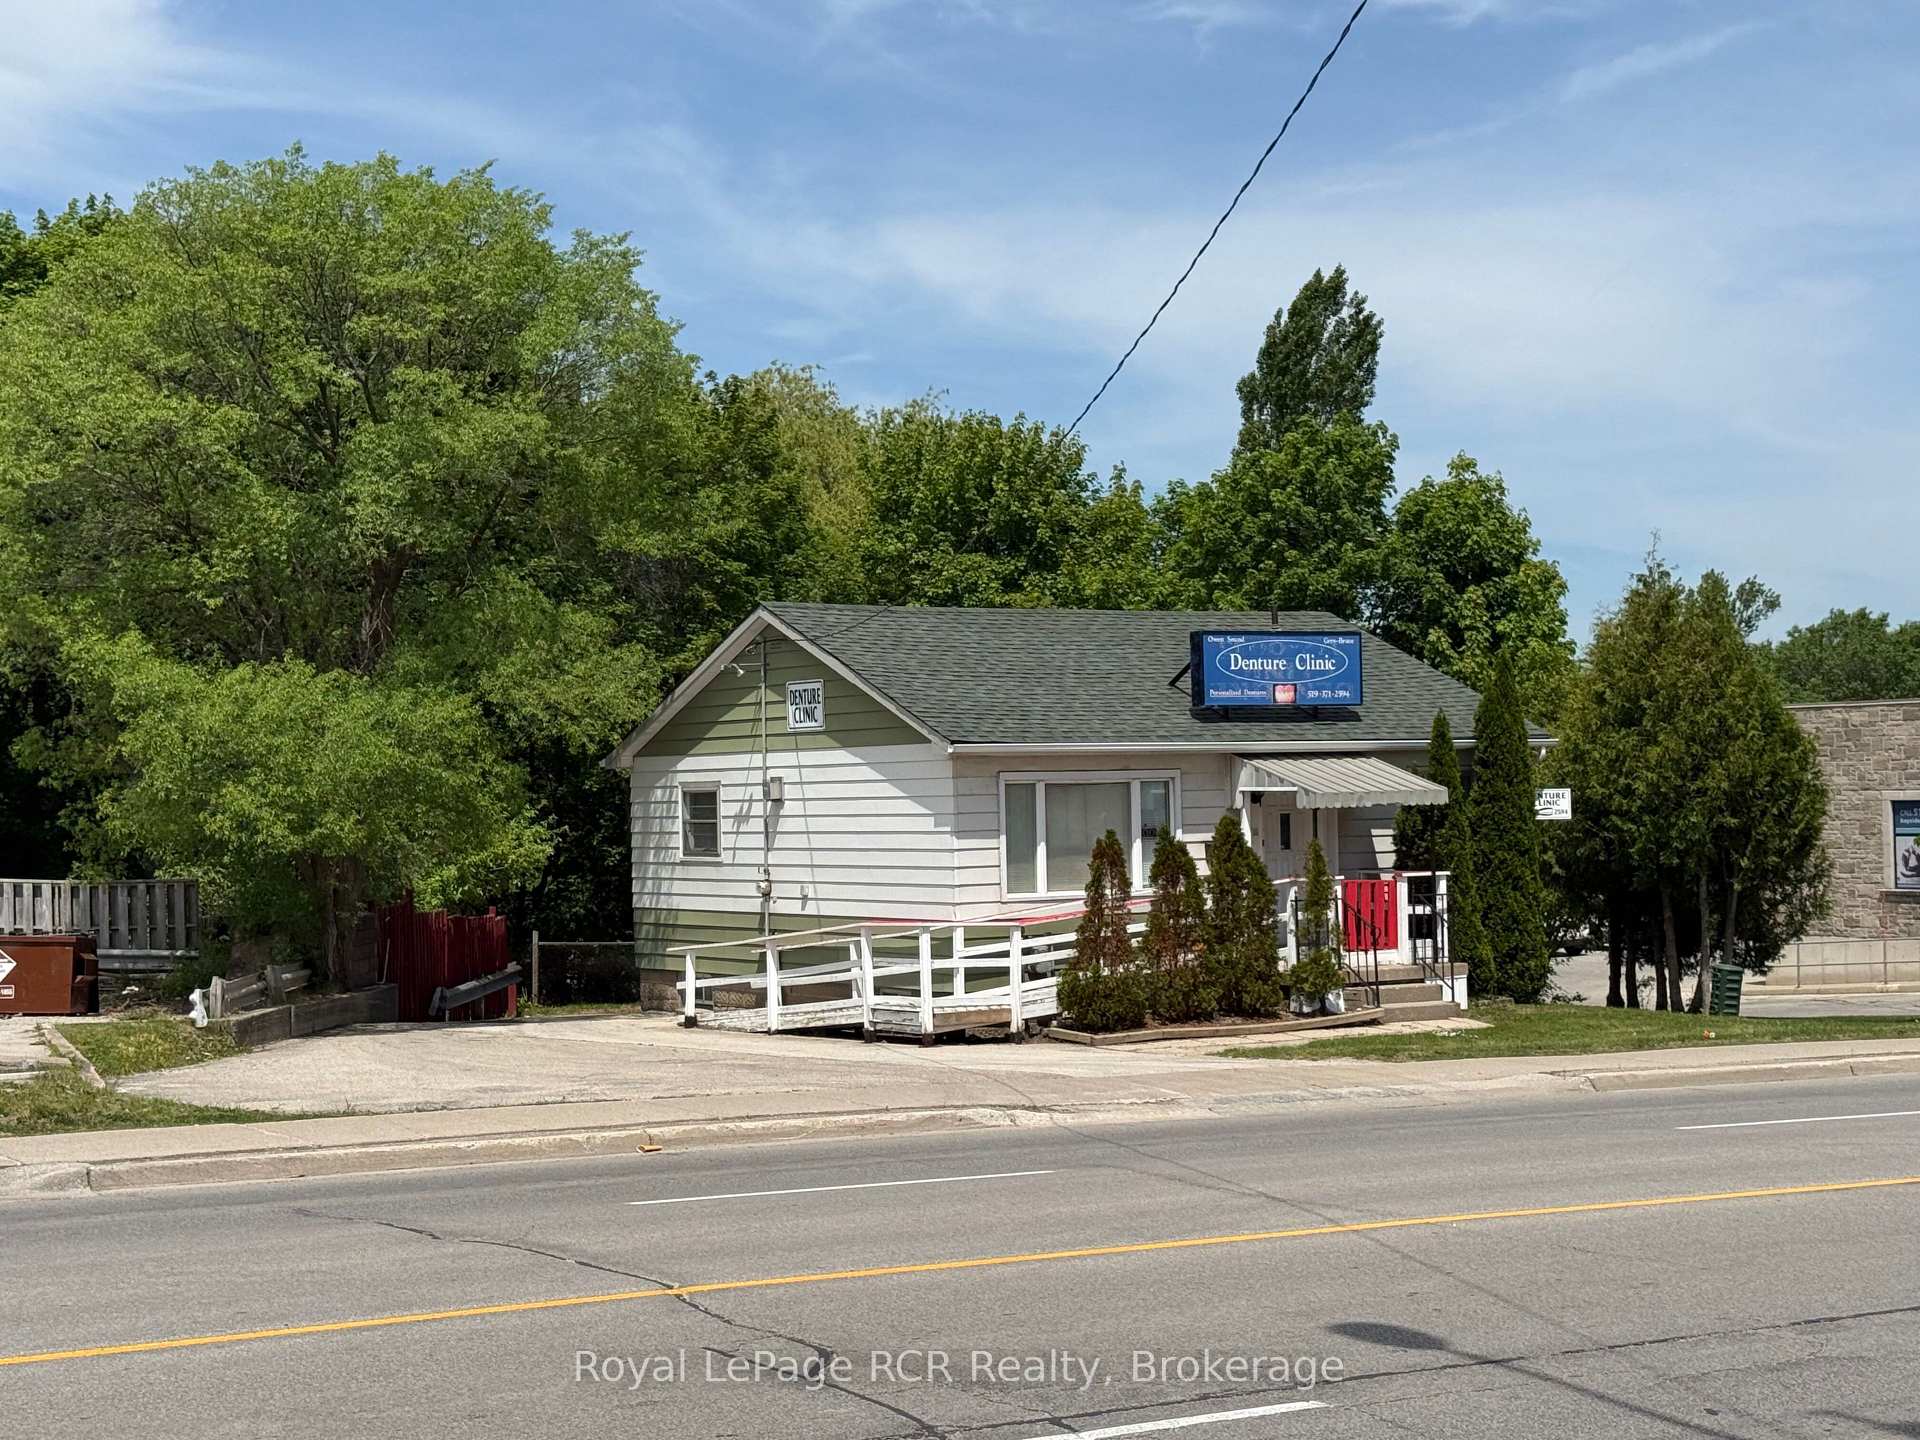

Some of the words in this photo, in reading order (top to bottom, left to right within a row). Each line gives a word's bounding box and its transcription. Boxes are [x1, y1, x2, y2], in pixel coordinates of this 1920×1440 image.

[1230, 653, 1287, 671] Denture
[1295, 653, 1336, 671] Clinic
[790, 688, 821, 706] DENTURE
[794, 706, 818, 723] CLINIC
